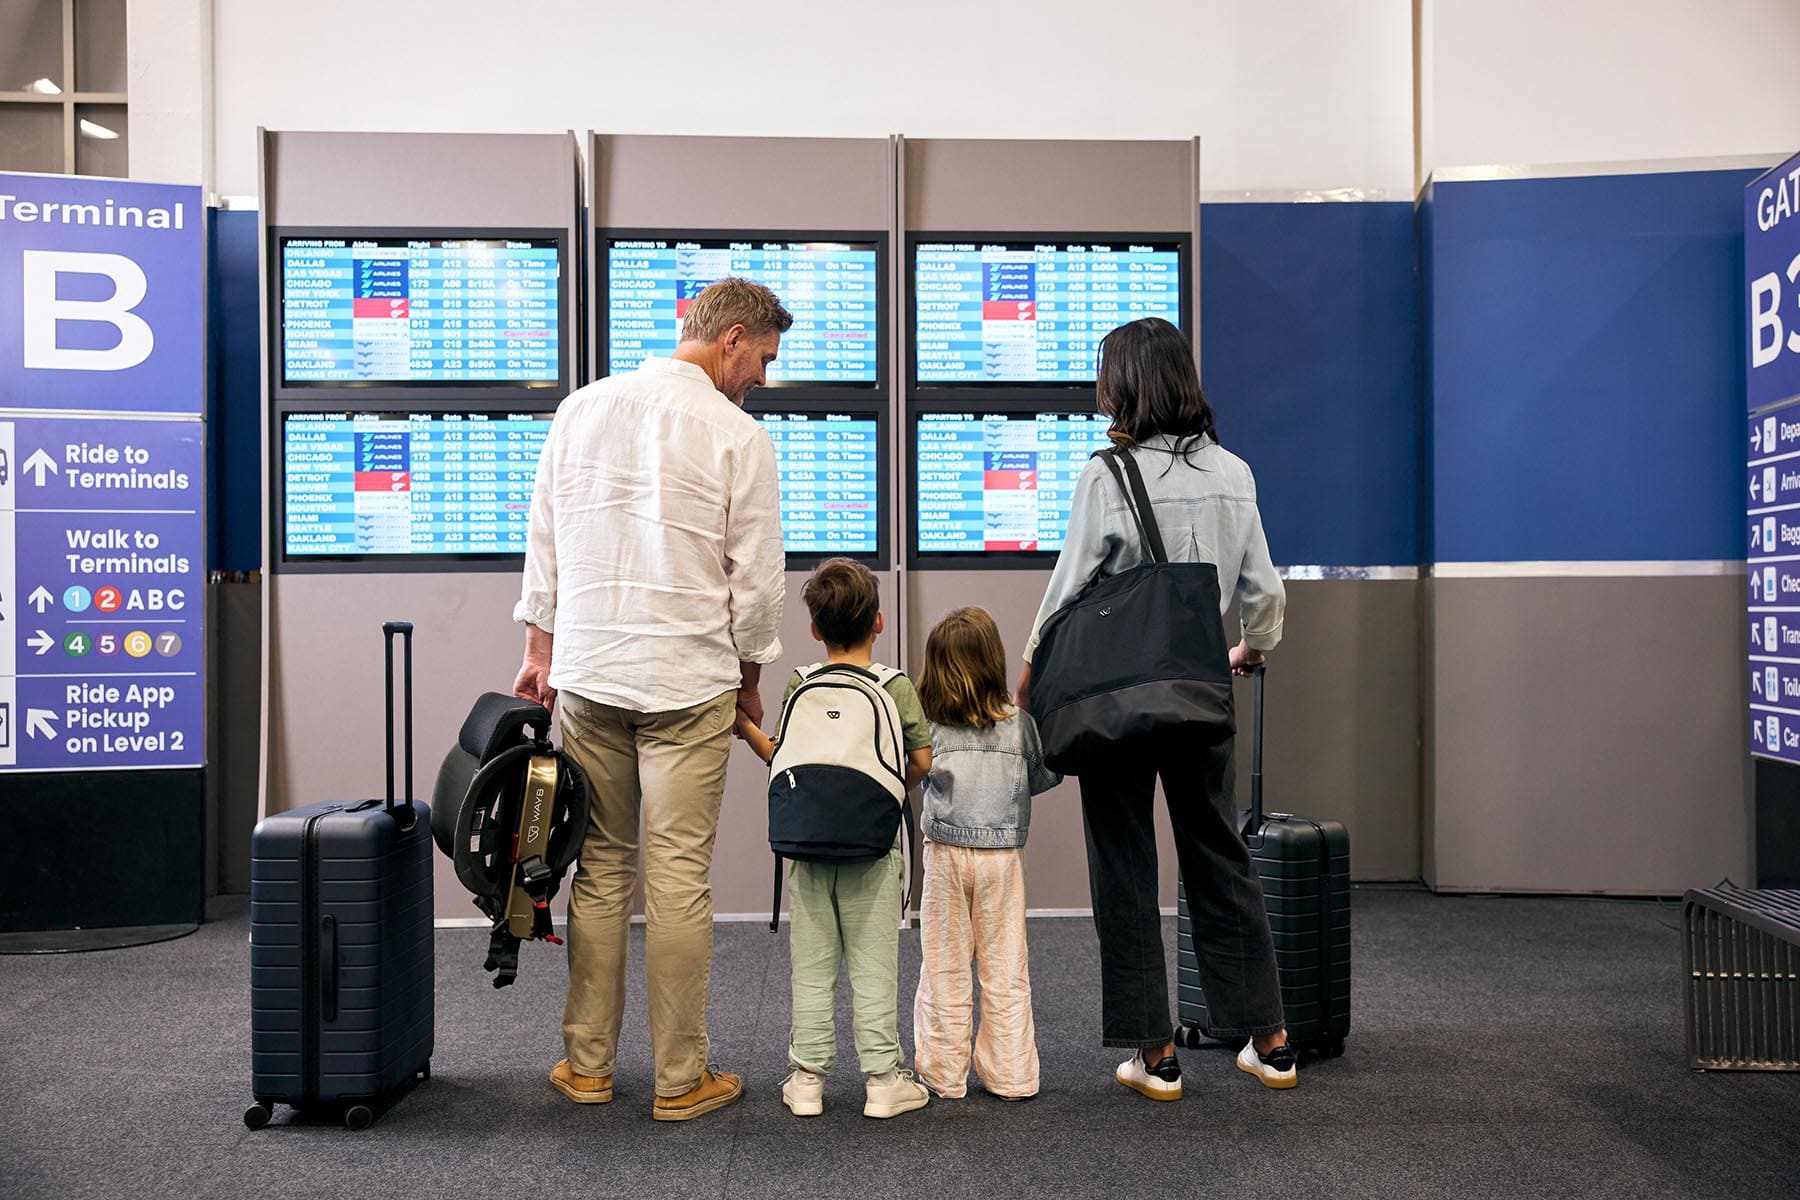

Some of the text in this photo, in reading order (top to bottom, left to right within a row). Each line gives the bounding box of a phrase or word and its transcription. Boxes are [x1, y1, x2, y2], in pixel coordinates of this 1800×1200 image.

[0, 195, 184, 230] Terminal
[23, 249, 155, 371] B
[66, 443, 149, 465] Ride to
[66, 468, 189, 490] Terminals
[66, 529, 160, 550] Walk to
[66, 553, 190, 574] Terminals
[100, 590, 115, 609] 2
[68, 635, 177, 654] 4 5 6 7
[66, 684, 175, 708] Ride App
[66, 708, 150, 733] Pickup
[66, 731, 184, 753] on Level 2
[1784, 727, 1799, 748] Car
